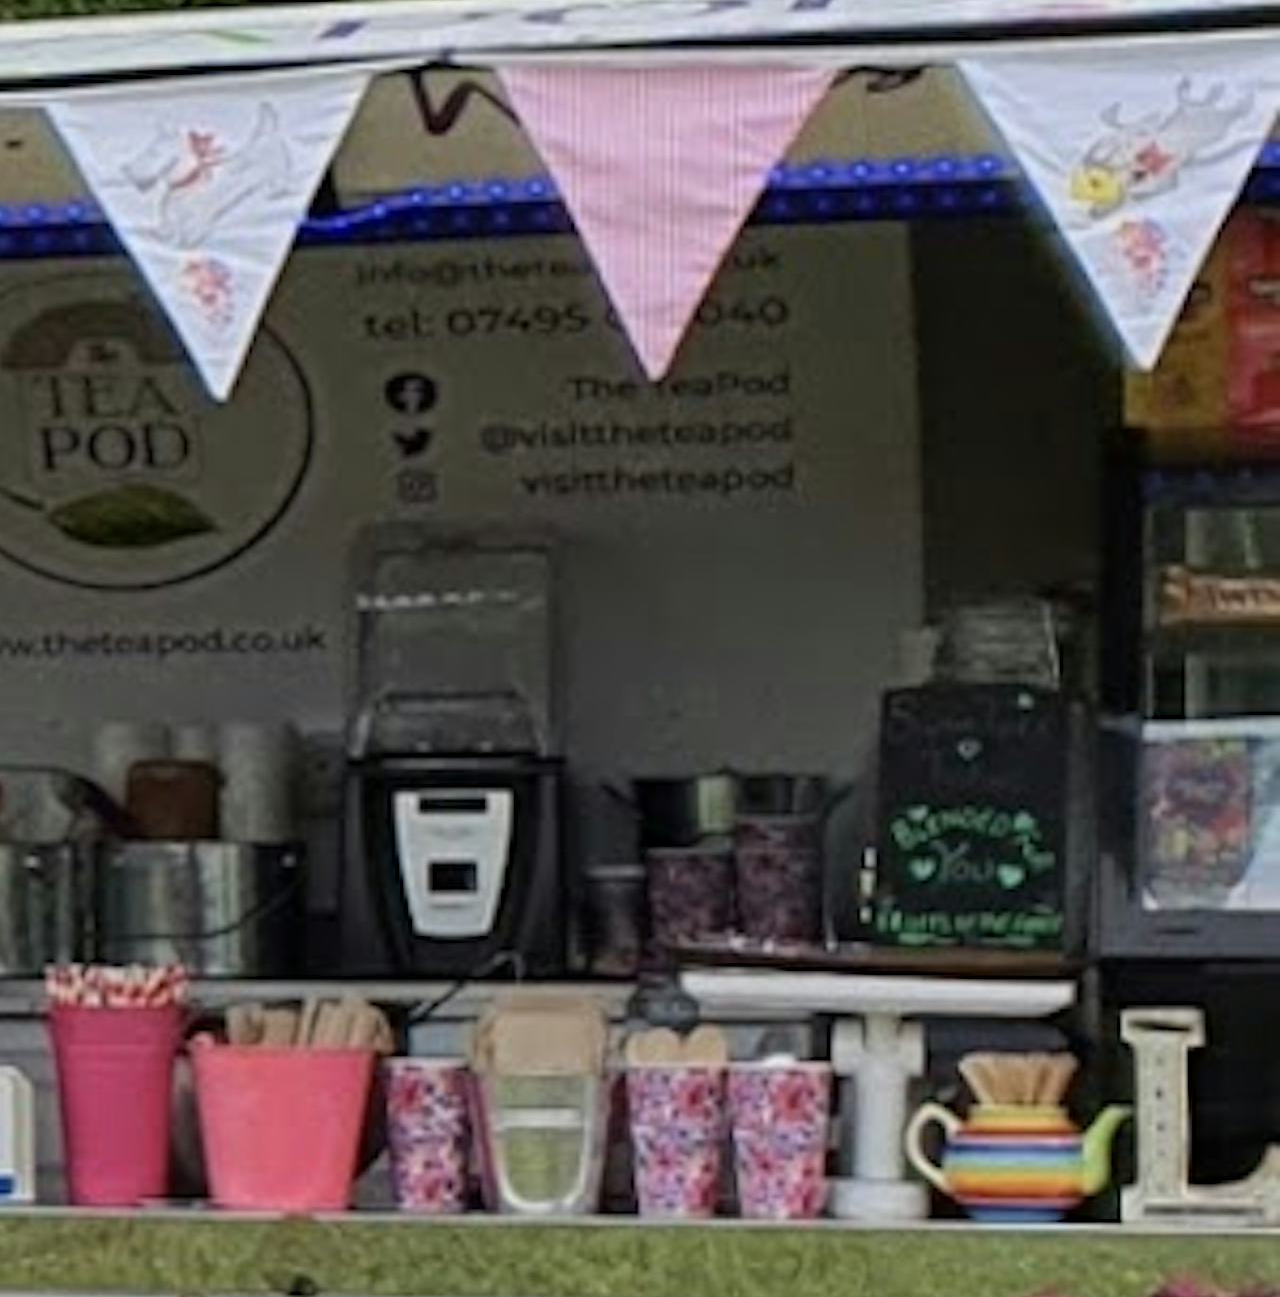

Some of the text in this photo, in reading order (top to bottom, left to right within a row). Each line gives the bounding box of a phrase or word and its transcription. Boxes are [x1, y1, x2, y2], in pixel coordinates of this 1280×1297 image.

[363, 308, 434, 339] tel:
[446, 302, 591, 336] 07495
[37, 376, 180, 419] TEA
[567, 376, 637, 399] The
[40, 424, 191, 472] POD
[479, 417, 793, 454] @visittheteapod
[520, 461, 795, 495] visittheteapod
